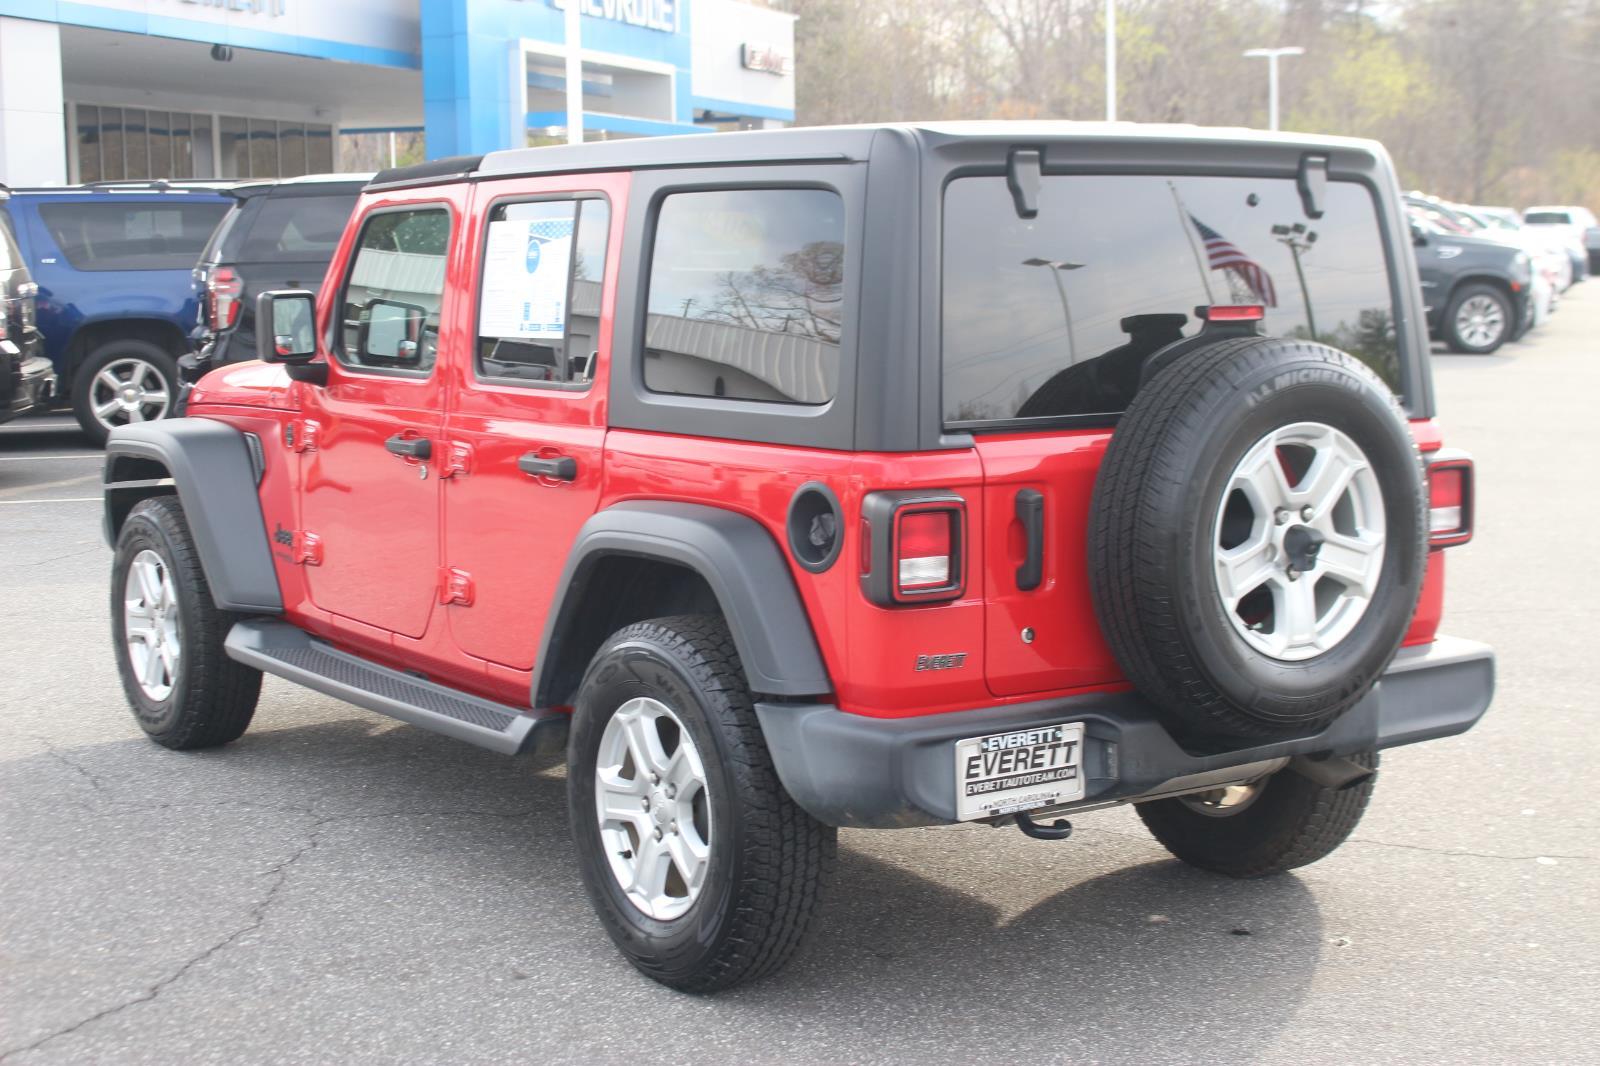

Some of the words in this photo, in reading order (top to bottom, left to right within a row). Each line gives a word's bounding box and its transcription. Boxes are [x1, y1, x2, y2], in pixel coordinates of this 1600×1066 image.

[547, 0, 681, 33] ROLET
[1274, 368, 1366, 394] MICHELIN
[988, 729, 1055, 751] EVERETT
[966, 741, 1078, 779] EVERETT
[967, 768, 1076, 794] EVERETTAUTOTEAM.COM
